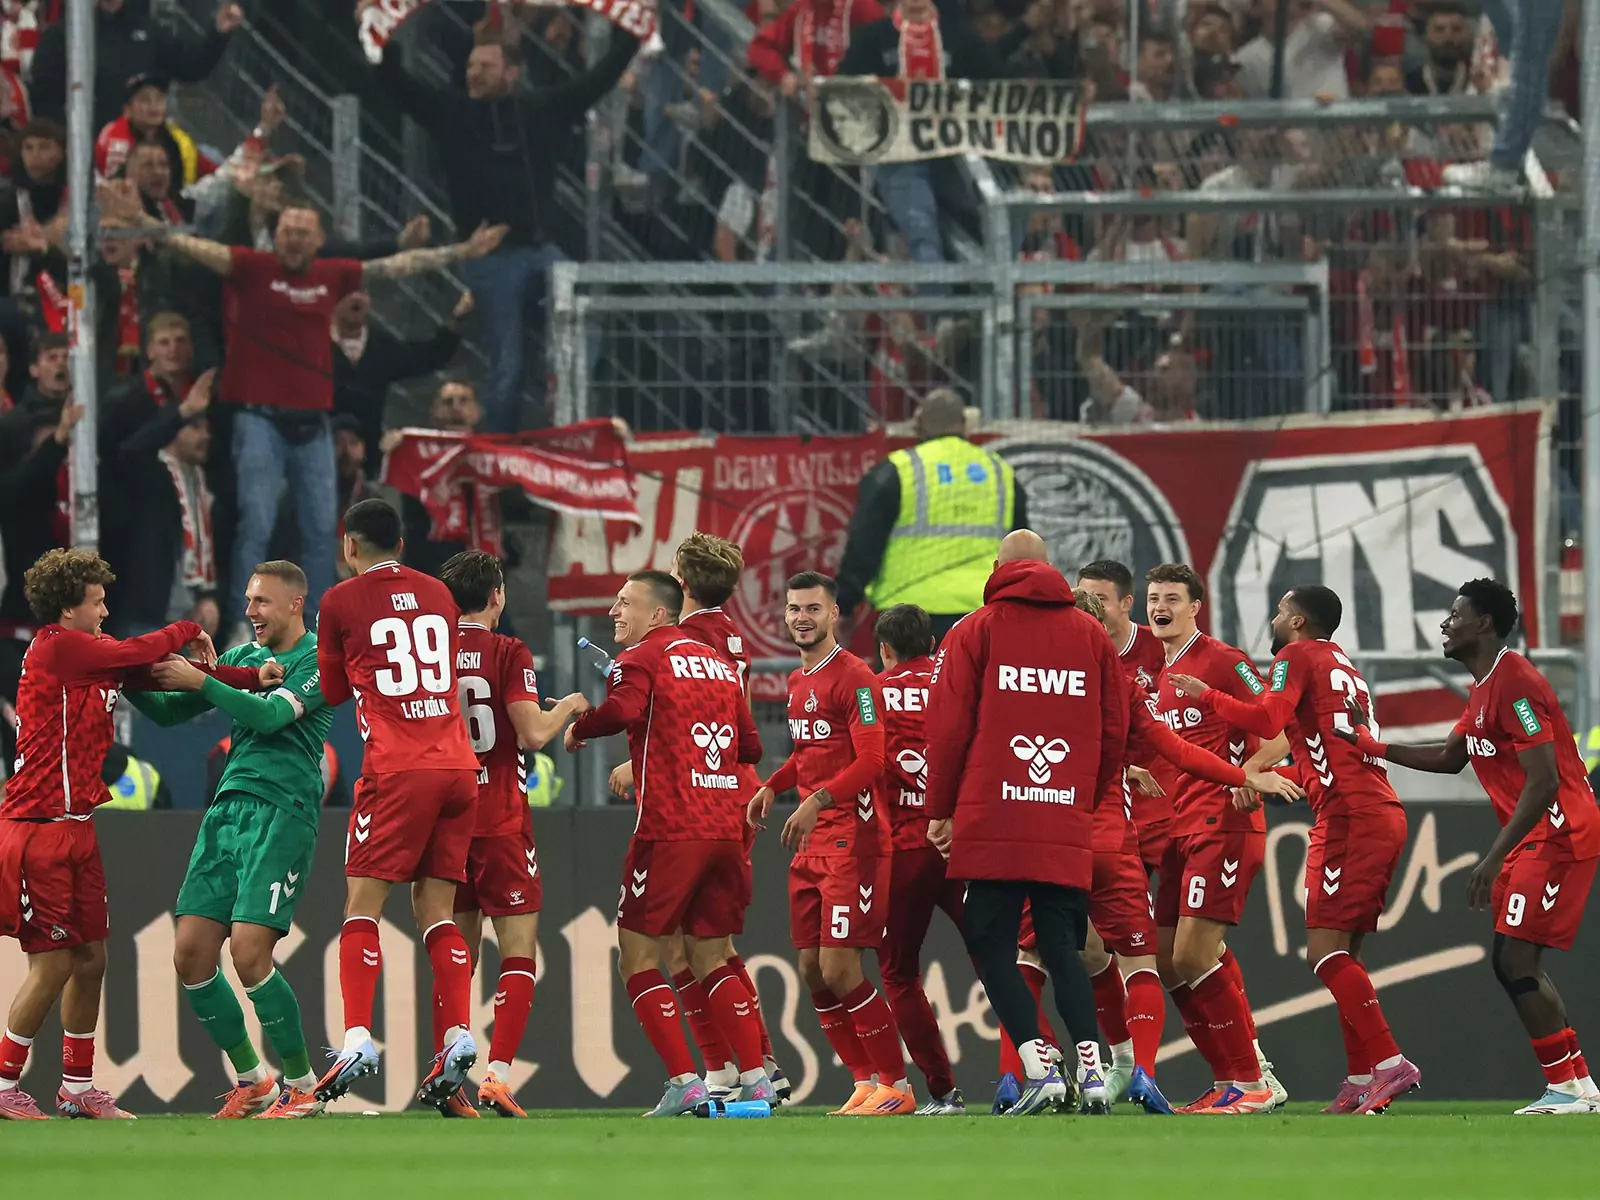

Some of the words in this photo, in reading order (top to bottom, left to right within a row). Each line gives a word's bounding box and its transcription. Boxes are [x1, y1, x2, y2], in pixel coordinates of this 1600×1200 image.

[911, 118, 993, 152] CON
[713, 455, 778, 490] DEIN
[390, 592, 419, 612] CENK
[369, 613, 451, 697] 39
[456, 649, 481, 670] ŃSKI
[669, 655, 738, 684] REWE
[930, 647, 948, 684] DEVK
[998, 664, 1087, 697] REWE
[1237, 664, 1261, 693] DEVK
[1273, 663, 1285, 690] DEVK
[457, 675, 497, 754] 6
[862, 690, 874, 723] DEVK
[882, 687, 930, 712] RE
[1517, 702, 1538, 733] DEVK
[691, 768, 739, 790] humme
[1002, 780, 1075, 806] hummel
[269, 881, 281, 915] 1
[1187, 875, 1207, 909] 6
[830, 905, 850, 940] 5
[1506, 893, 1527, 927] 9
